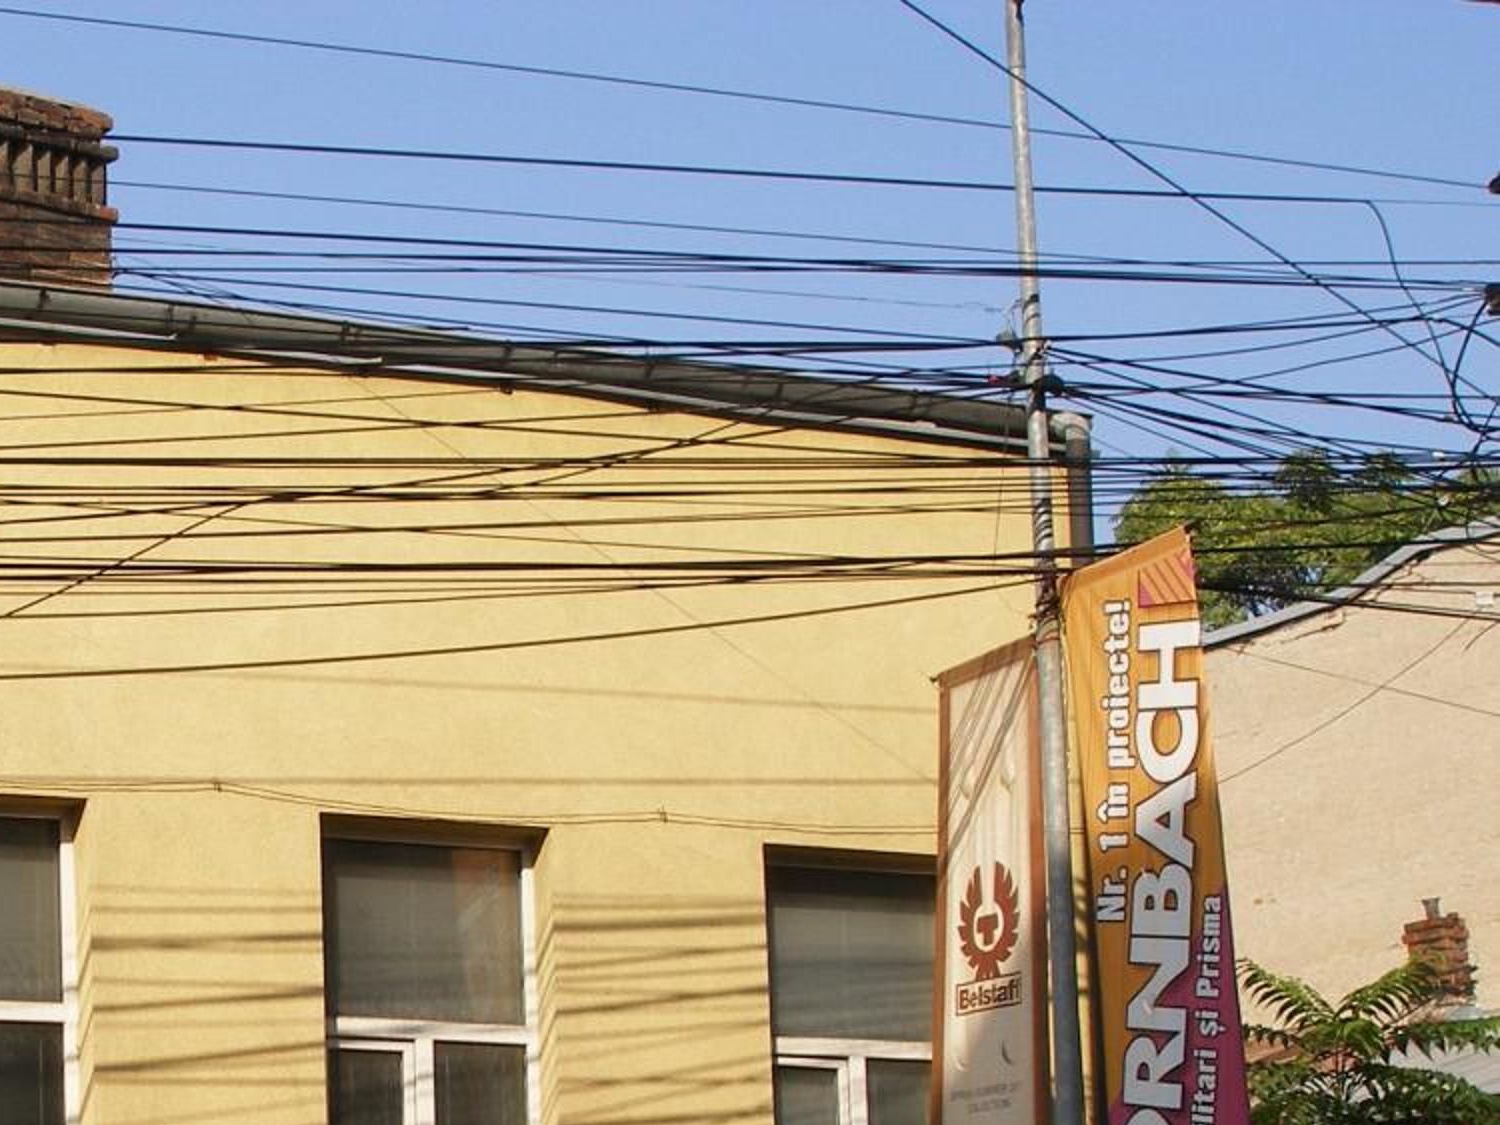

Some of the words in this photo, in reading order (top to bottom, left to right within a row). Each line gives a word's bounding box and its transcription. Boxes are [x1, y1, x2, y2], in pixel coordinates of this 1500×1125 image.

[1101, 598, 1136, 768] proiecte!
[1097, 783, 1130, 824] în
[1099, 832, 1128, 853] 1
[1097, 866, 1128, 922] Nr.
[1196, 896, 1222, 998] Prisma
[959, 977, 1020, 1010] Belstaff
